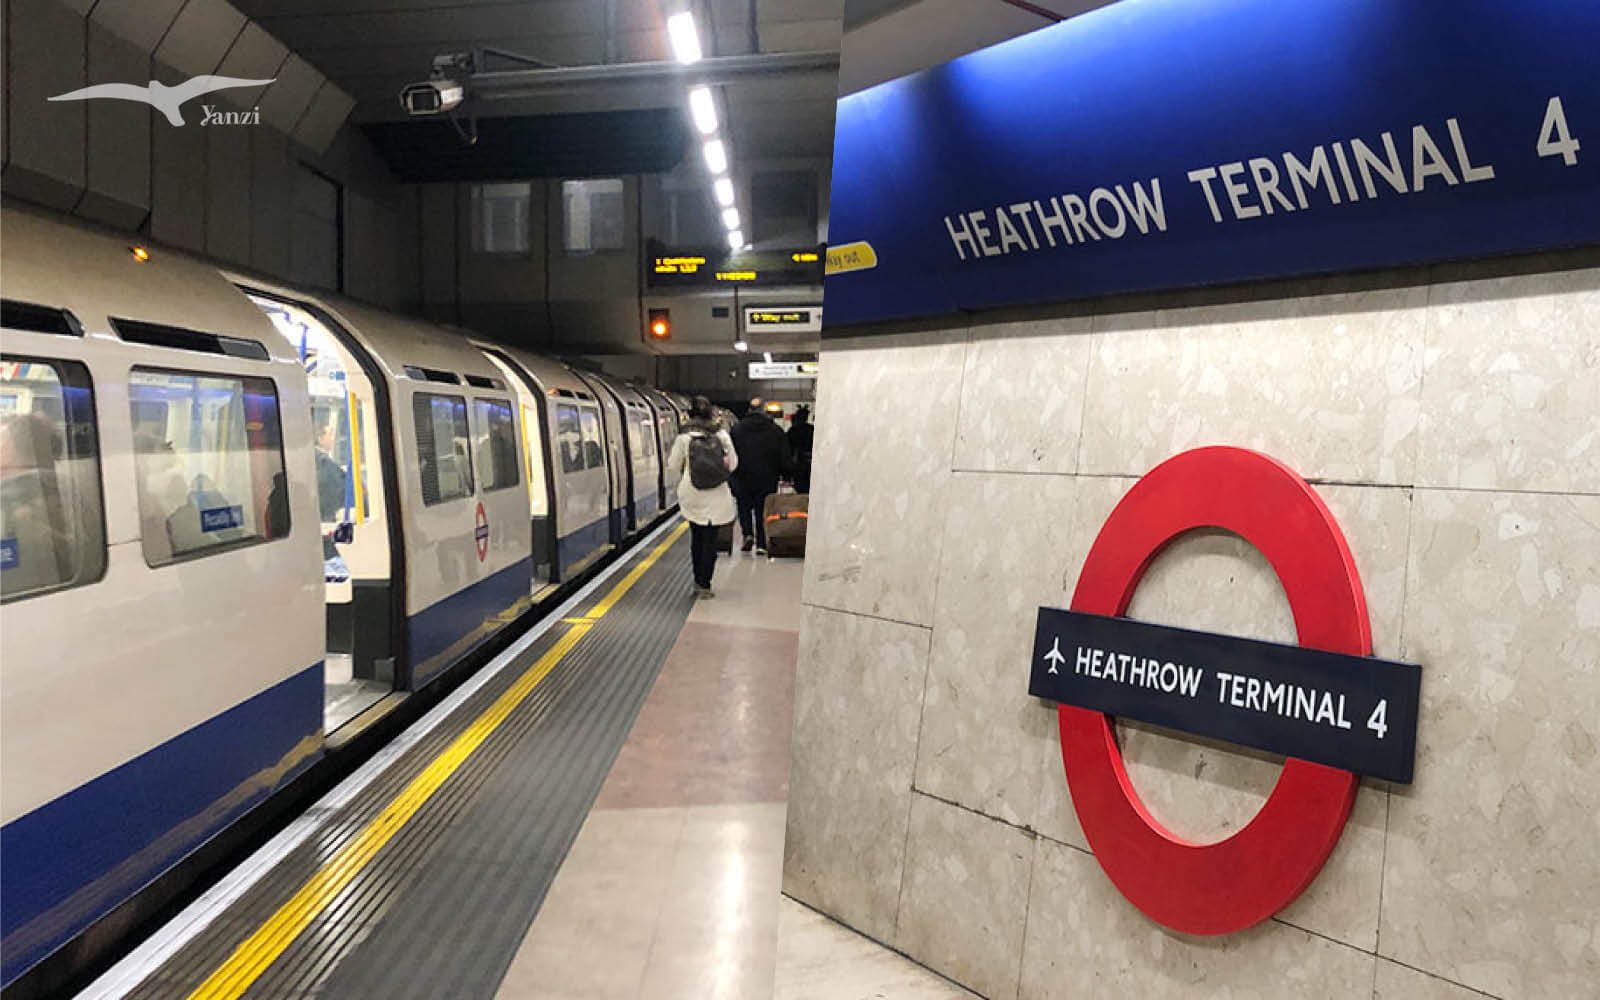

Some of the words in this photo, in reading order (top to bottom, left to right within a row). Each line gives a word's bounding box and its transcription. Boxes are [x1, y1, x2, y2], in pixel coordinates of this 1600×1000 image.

[944, 177, 1168, 261] HEATHROW
[1187, 117, 1496, 223] TERMINAL
[1536, 96, 1581, 167] 4
[1075, 646, 1203, 698] HEATHROW
[1216, 672, 1352, 730] TERMINAL
[1366, 699, 1388, 739] 4
